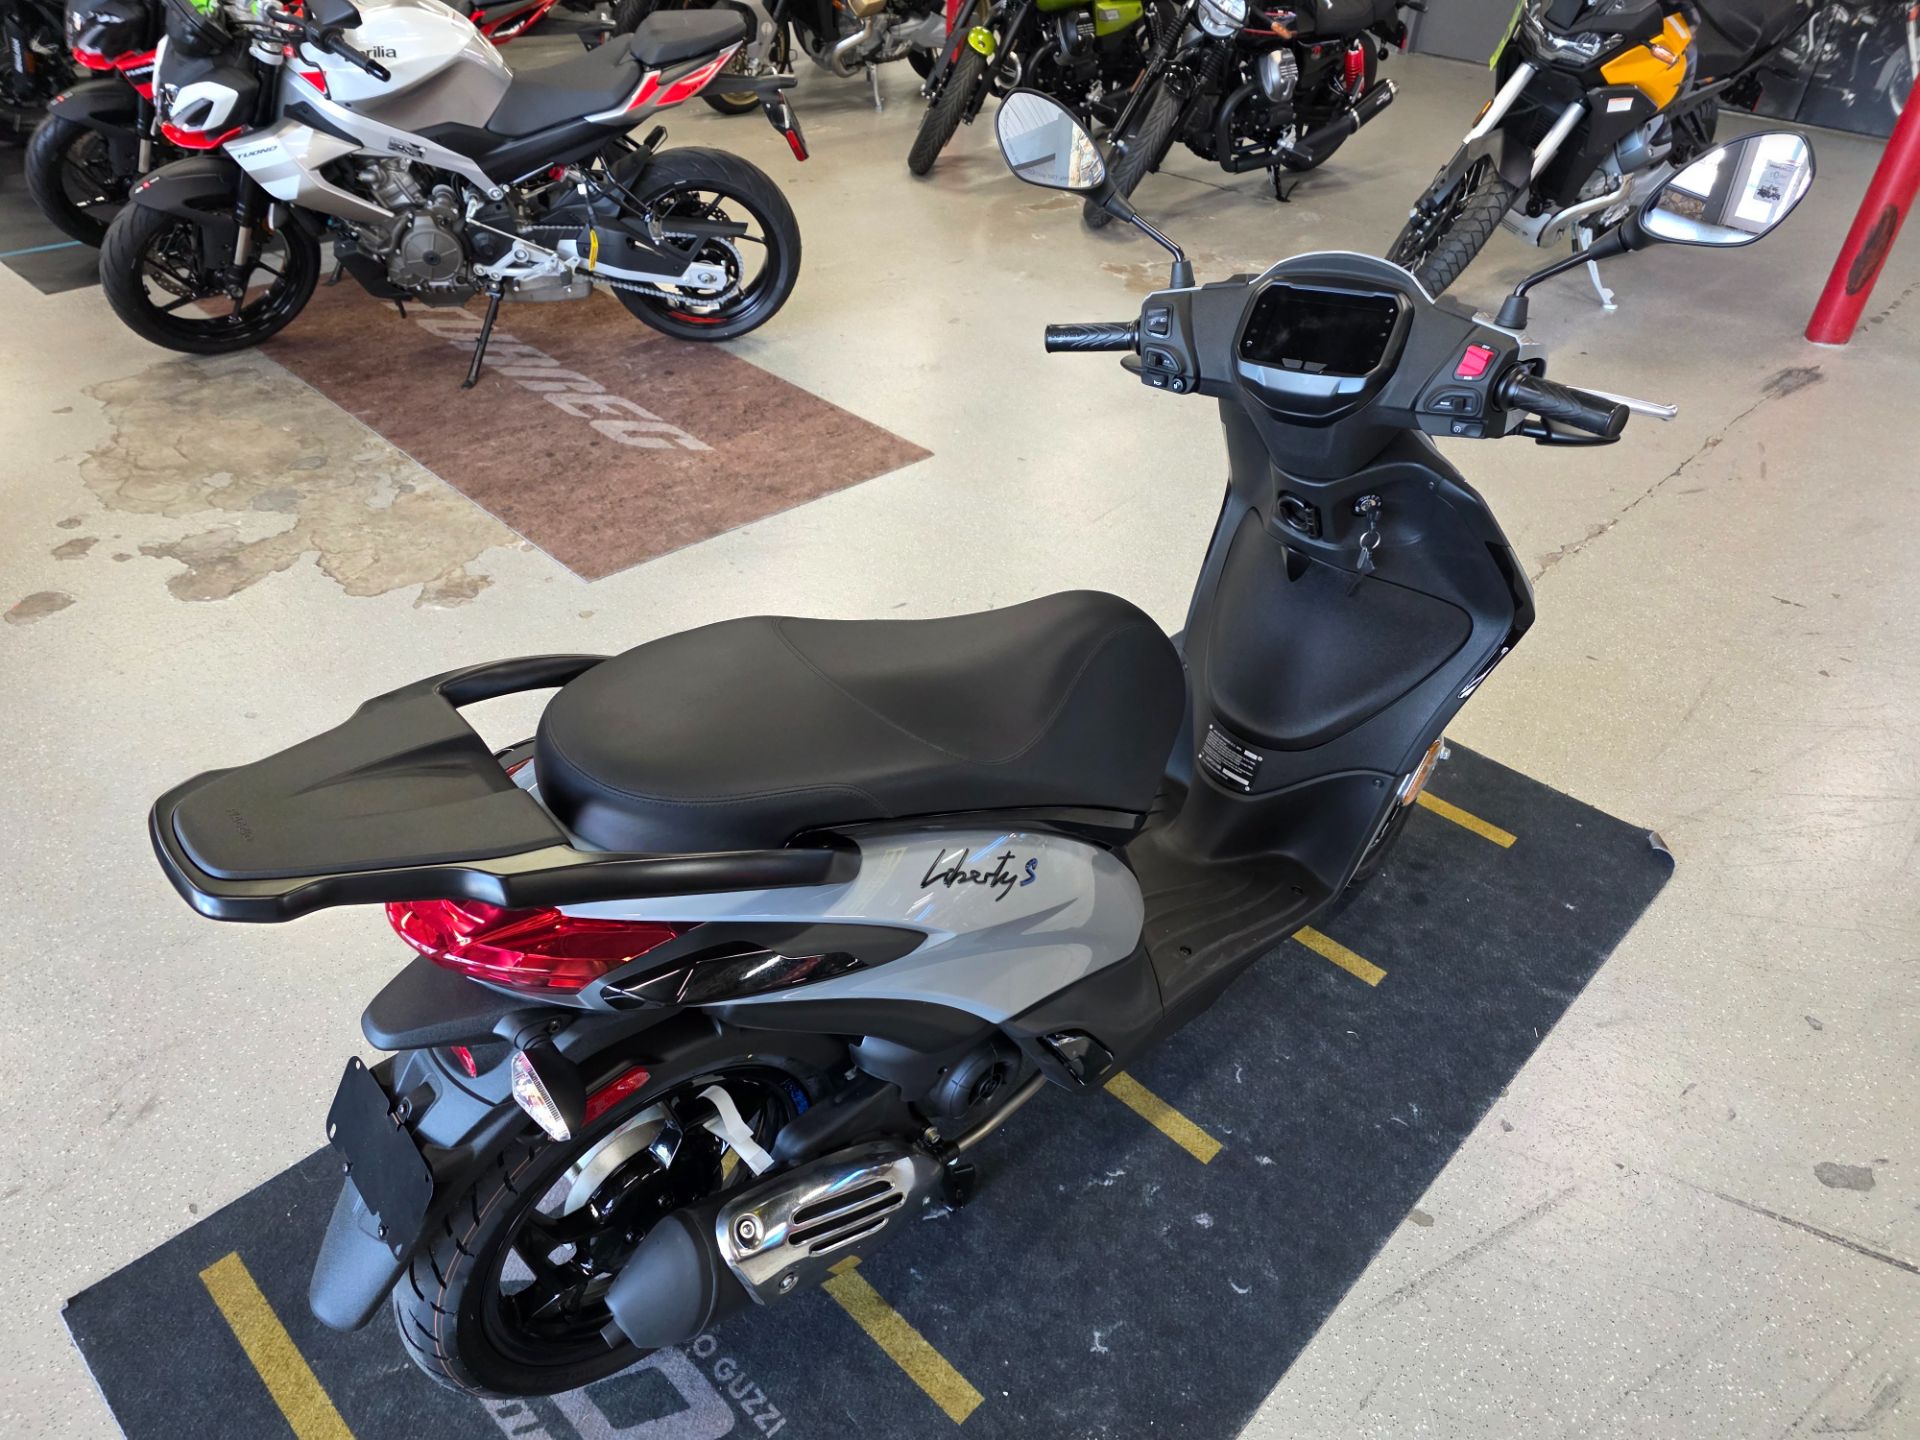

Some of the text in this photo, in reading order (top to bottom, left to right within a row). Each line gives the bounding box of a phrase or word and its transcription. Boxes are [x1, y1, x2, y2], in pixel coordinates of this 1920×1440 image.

[361, 46, 397, 58] rilia
[920, 848, 1039, 902] Liberty S
[713, 1357, 787, 1439] GUZZI
